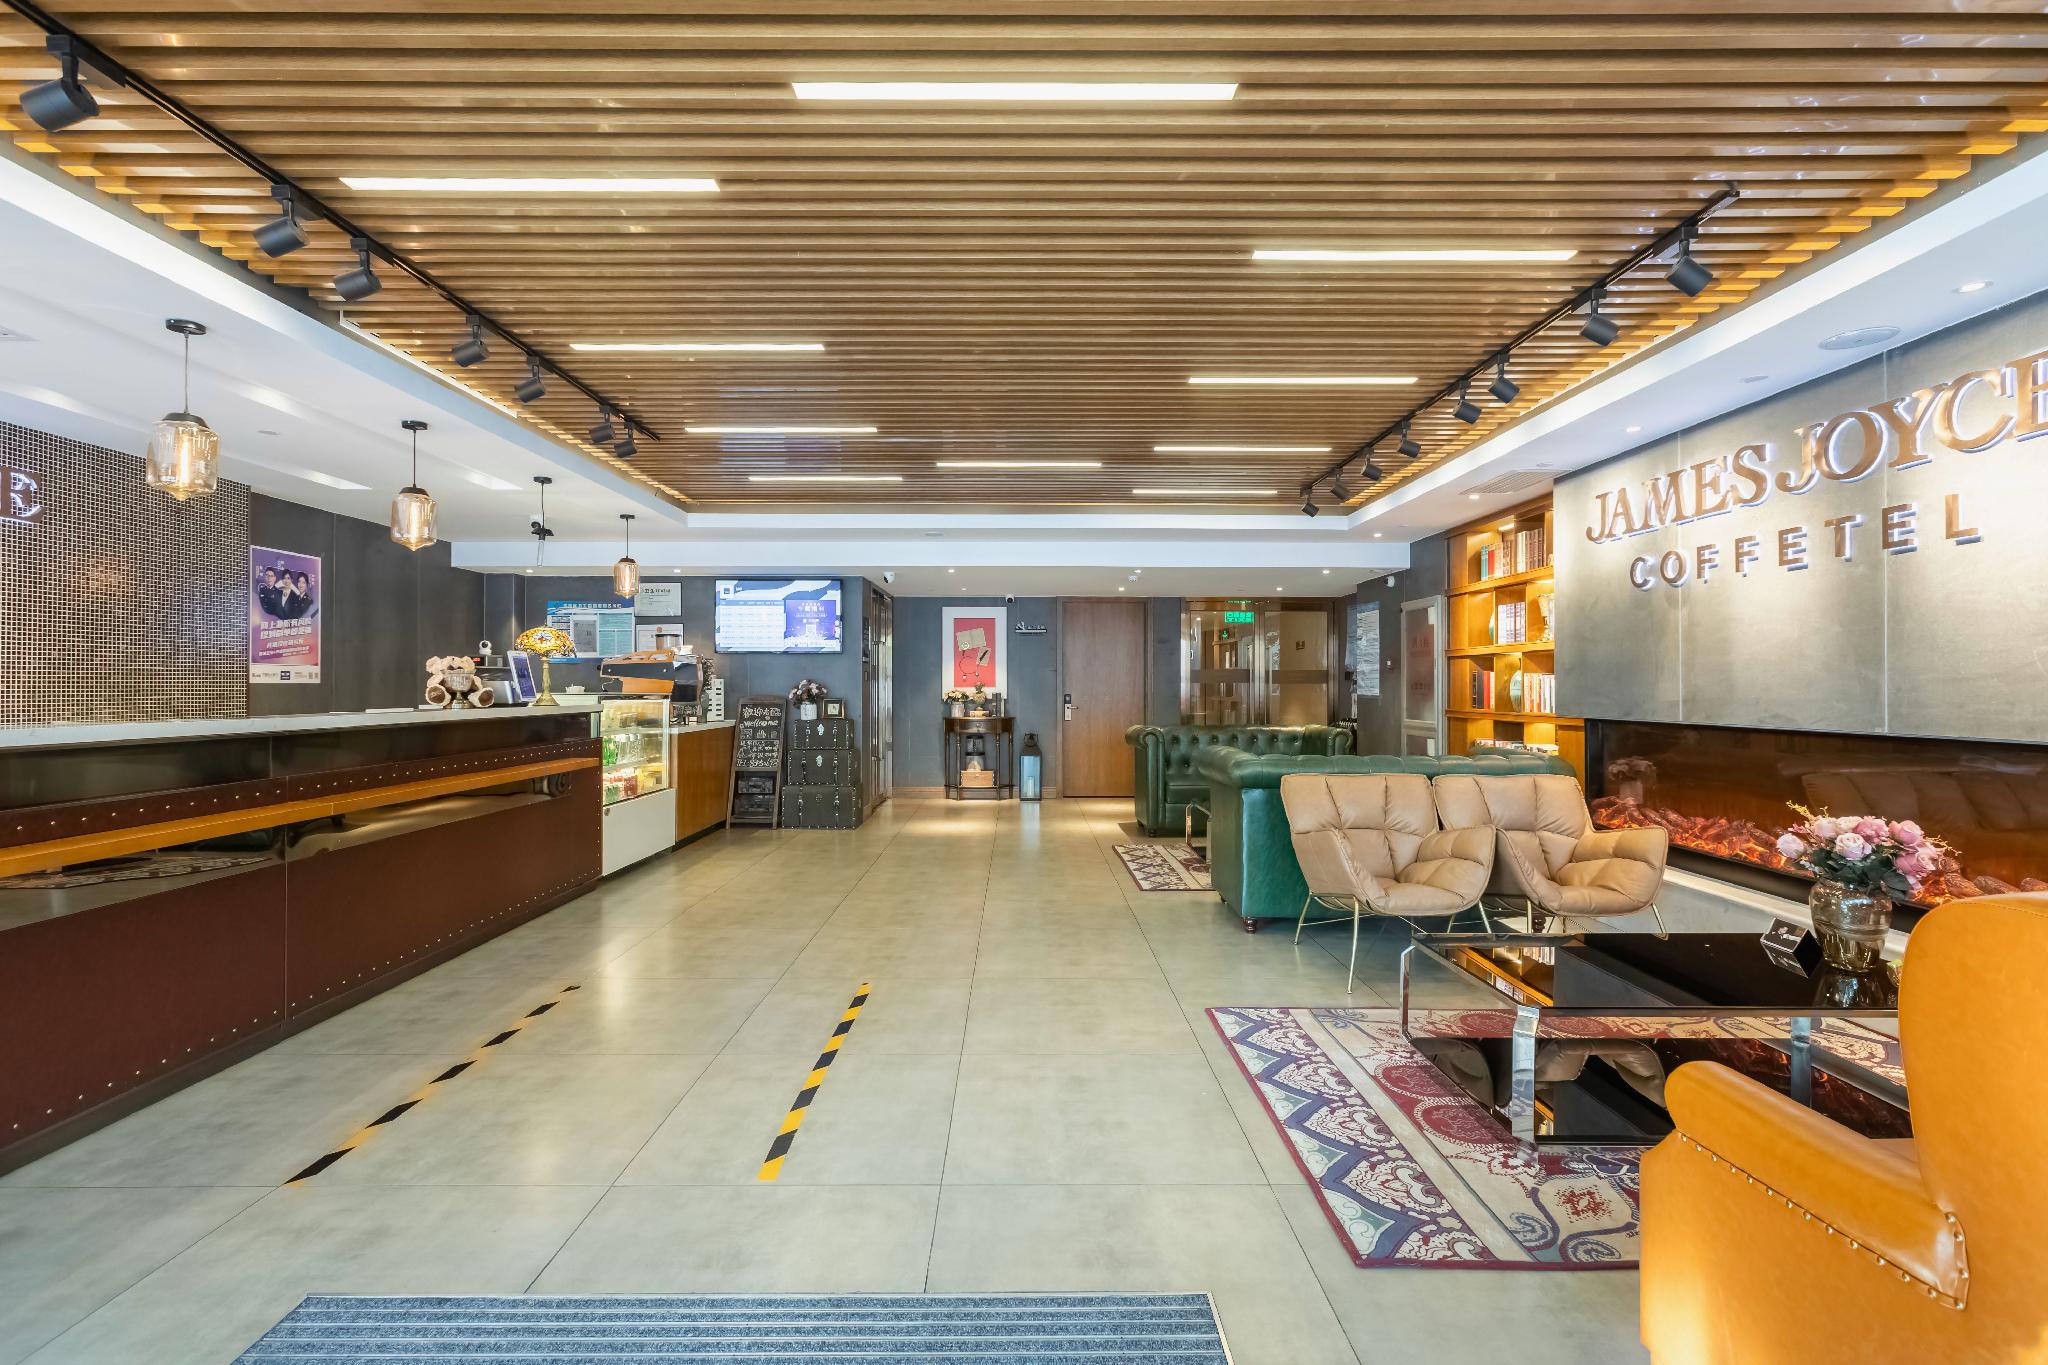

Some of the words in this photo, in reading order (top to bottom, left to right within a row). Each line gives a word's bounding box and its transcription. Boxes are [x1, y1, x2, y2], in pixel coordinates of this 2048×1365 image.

[1586, 443, 1770, 543] JAMES
[1775, 349, 2048, 494] JOYCE
[1630, 494, 1984, 590] COFFETEL
